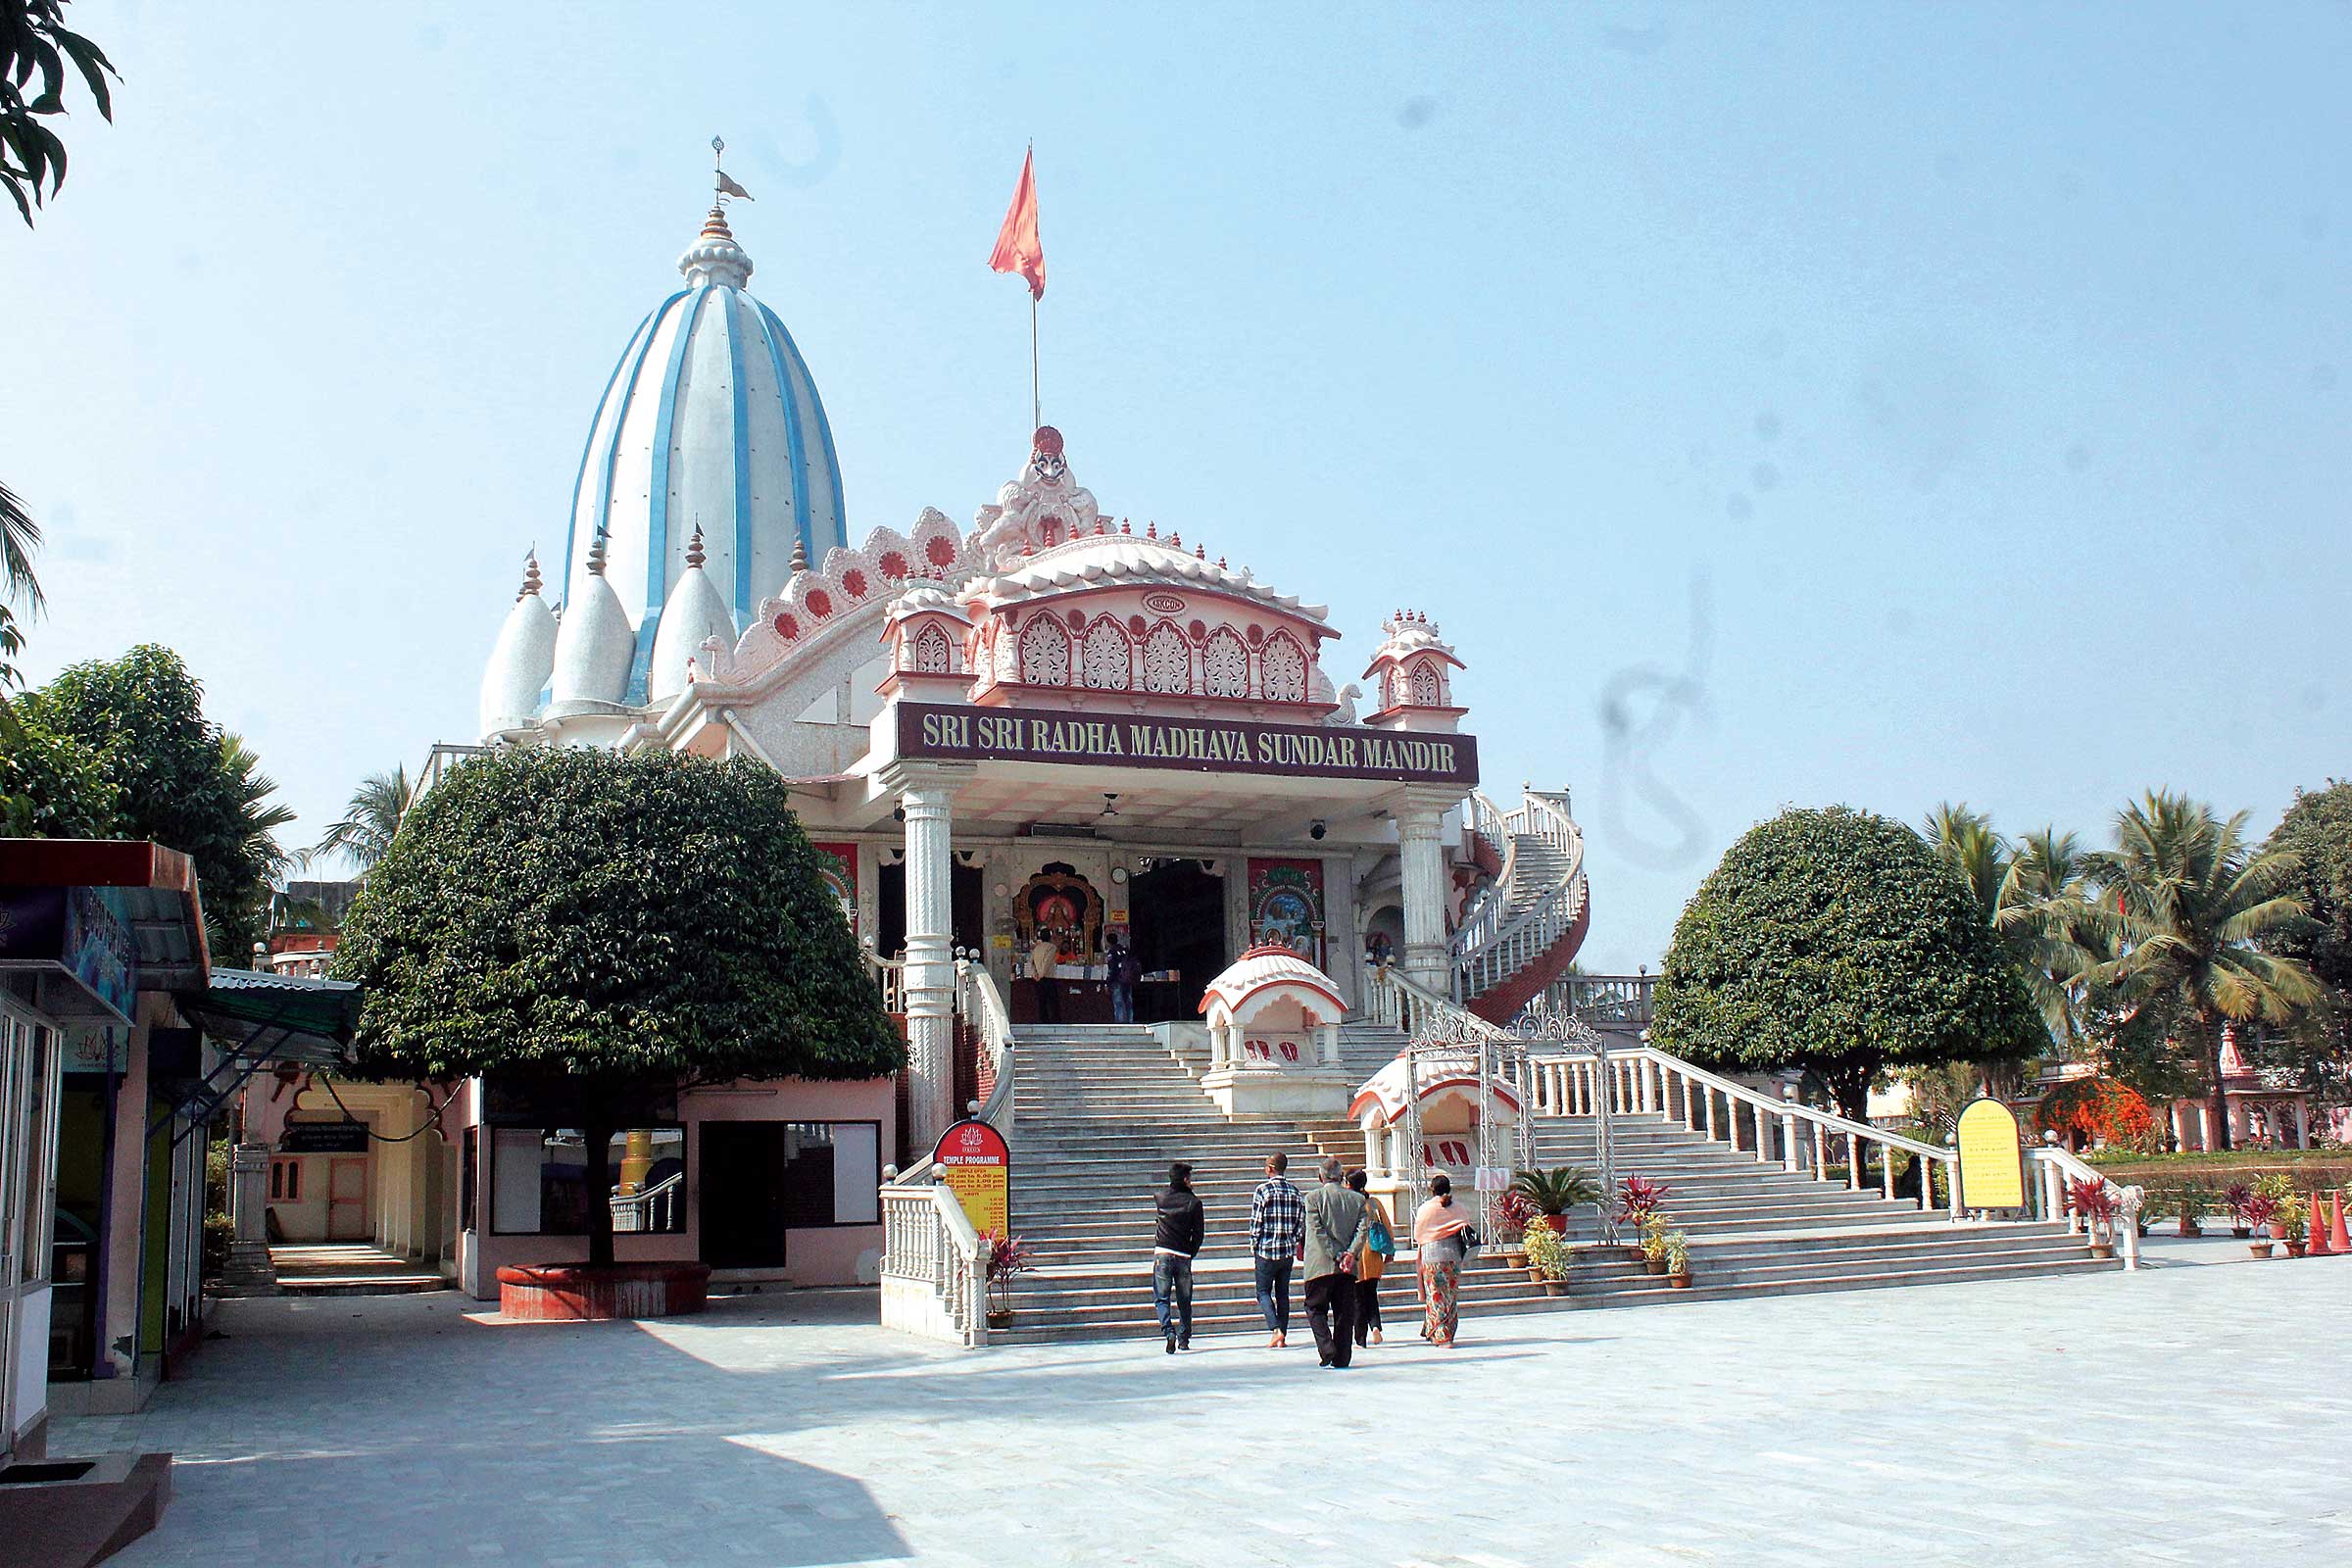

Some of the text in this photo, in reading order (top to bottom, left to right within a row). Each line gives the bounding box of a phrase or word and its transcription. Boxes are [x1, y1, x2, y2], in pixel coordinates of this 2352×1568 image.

[1152, 599, 1180, 610] ISKCON
[923, 713, 1457, 773] SRI SRI RADHA MADHAVA SUNDAR MANDIR
[944, 1155, 1001, 1164] TEMPLE PROGRAMME
[1480, 1169, 1506, 1190] IN
